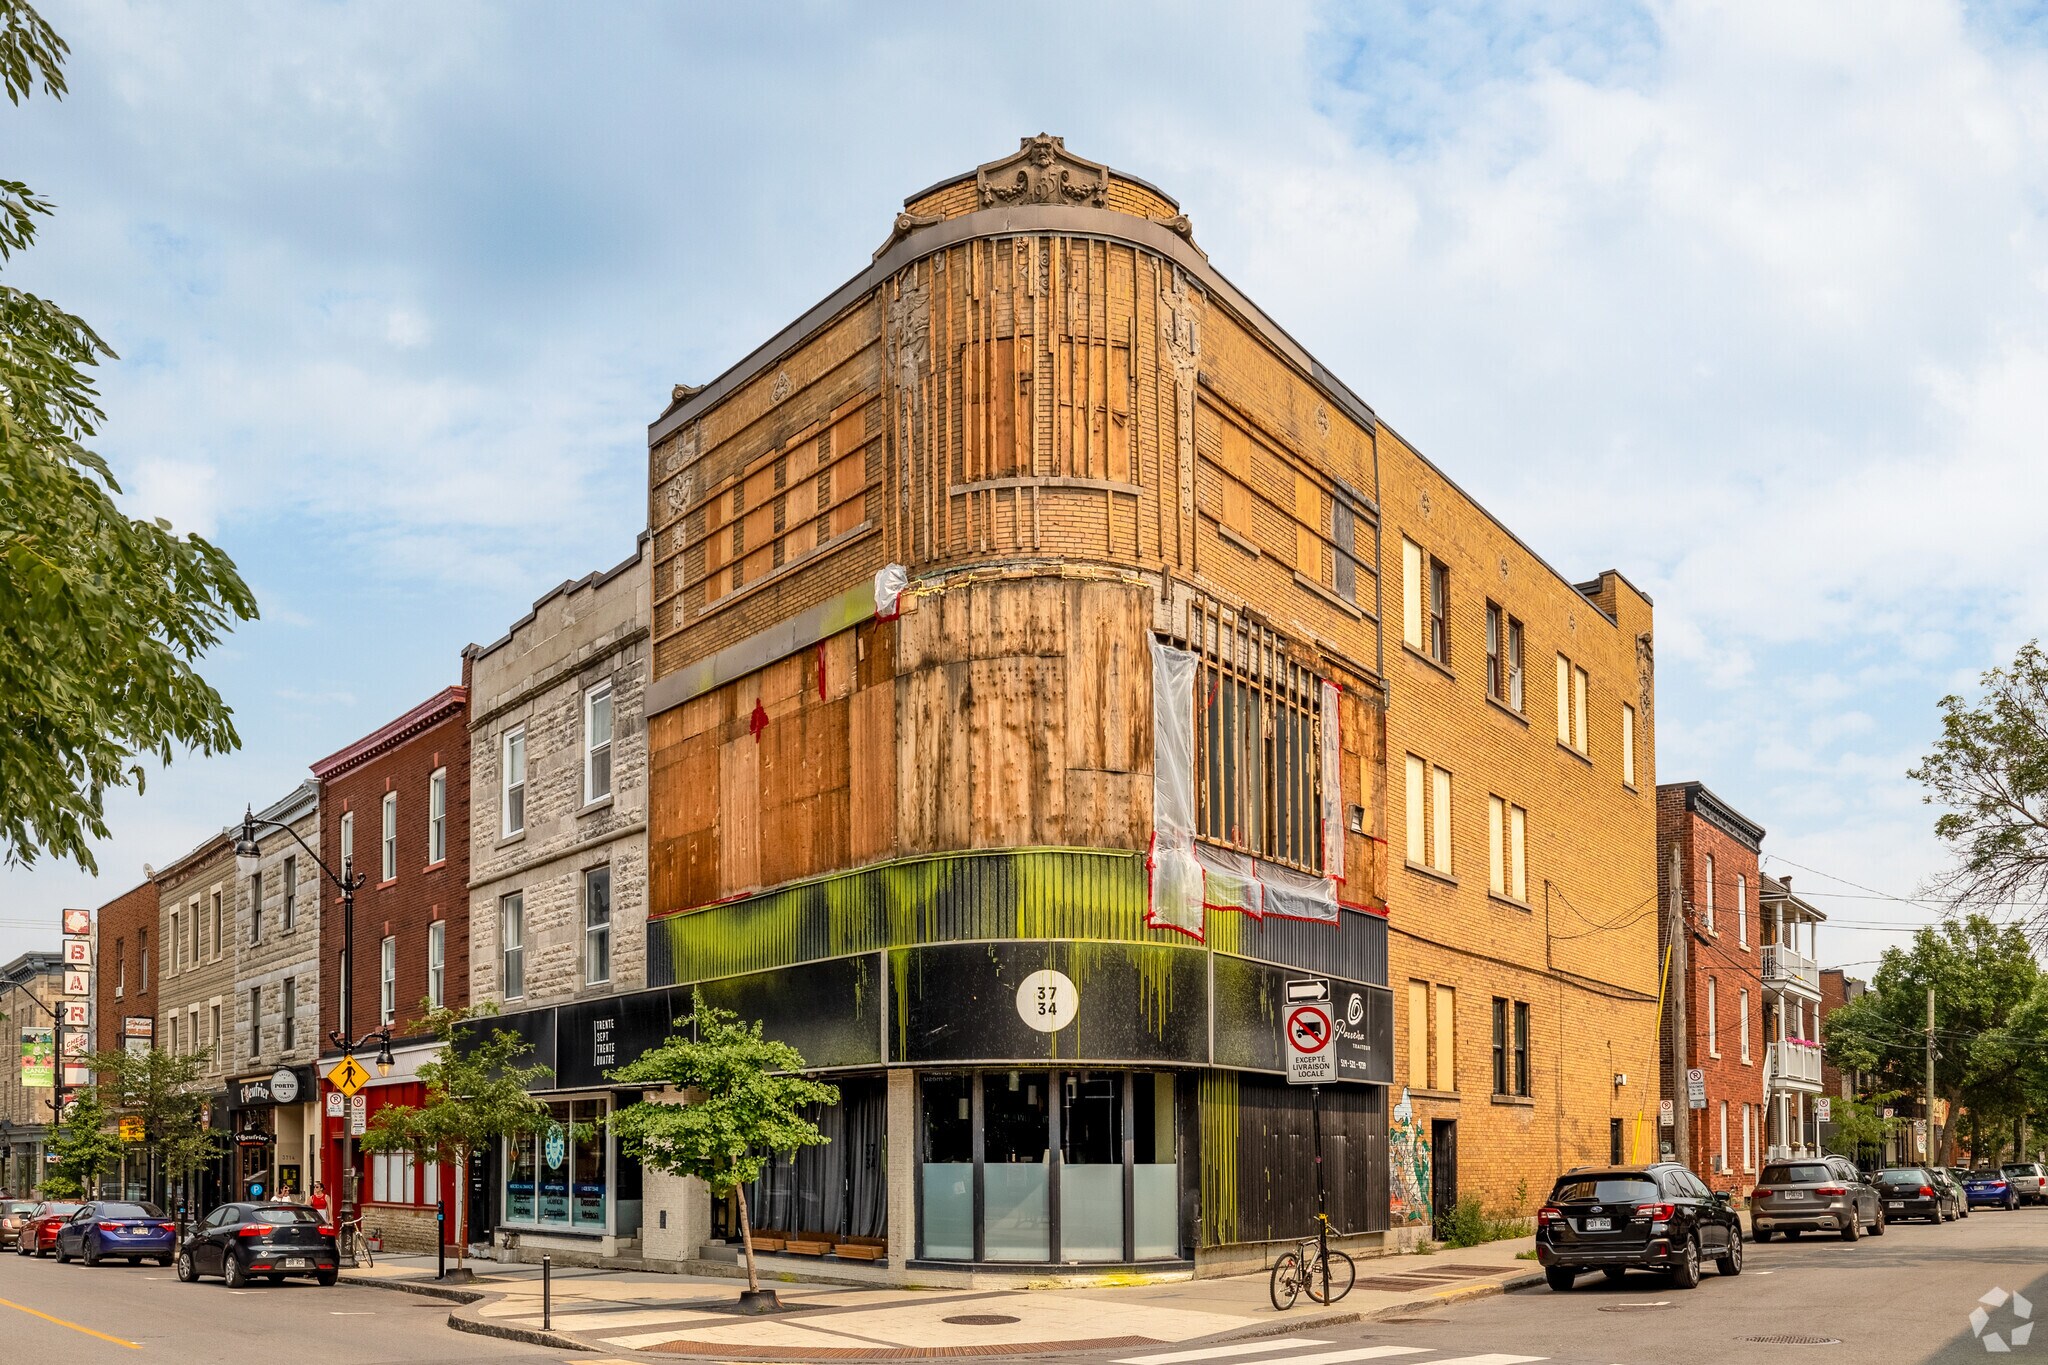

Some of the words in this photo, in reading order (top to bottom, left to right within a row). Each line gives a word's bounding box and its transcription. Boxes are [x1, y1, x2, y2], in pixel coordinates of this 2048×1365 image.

[1037, 986, 1057, 1000] 37
[1037, 1002, 1057, 1016] 34
[596, 1019, 614, 1030] TRENTE
[66, 1034, 84, 1048] CHEZ
[596, 1031, 609, 1042] SEPT
[596, 1043, 615, 1054] TRENTE
[596, 1055, 615, 1066] QUATRE
[1295, 1055, 1326, 1064] EXCEPTÉ
[1292, 1063, 1330, 1071] LIVRAISON
[1298, 1070, 1325, 1078] LOCALE
